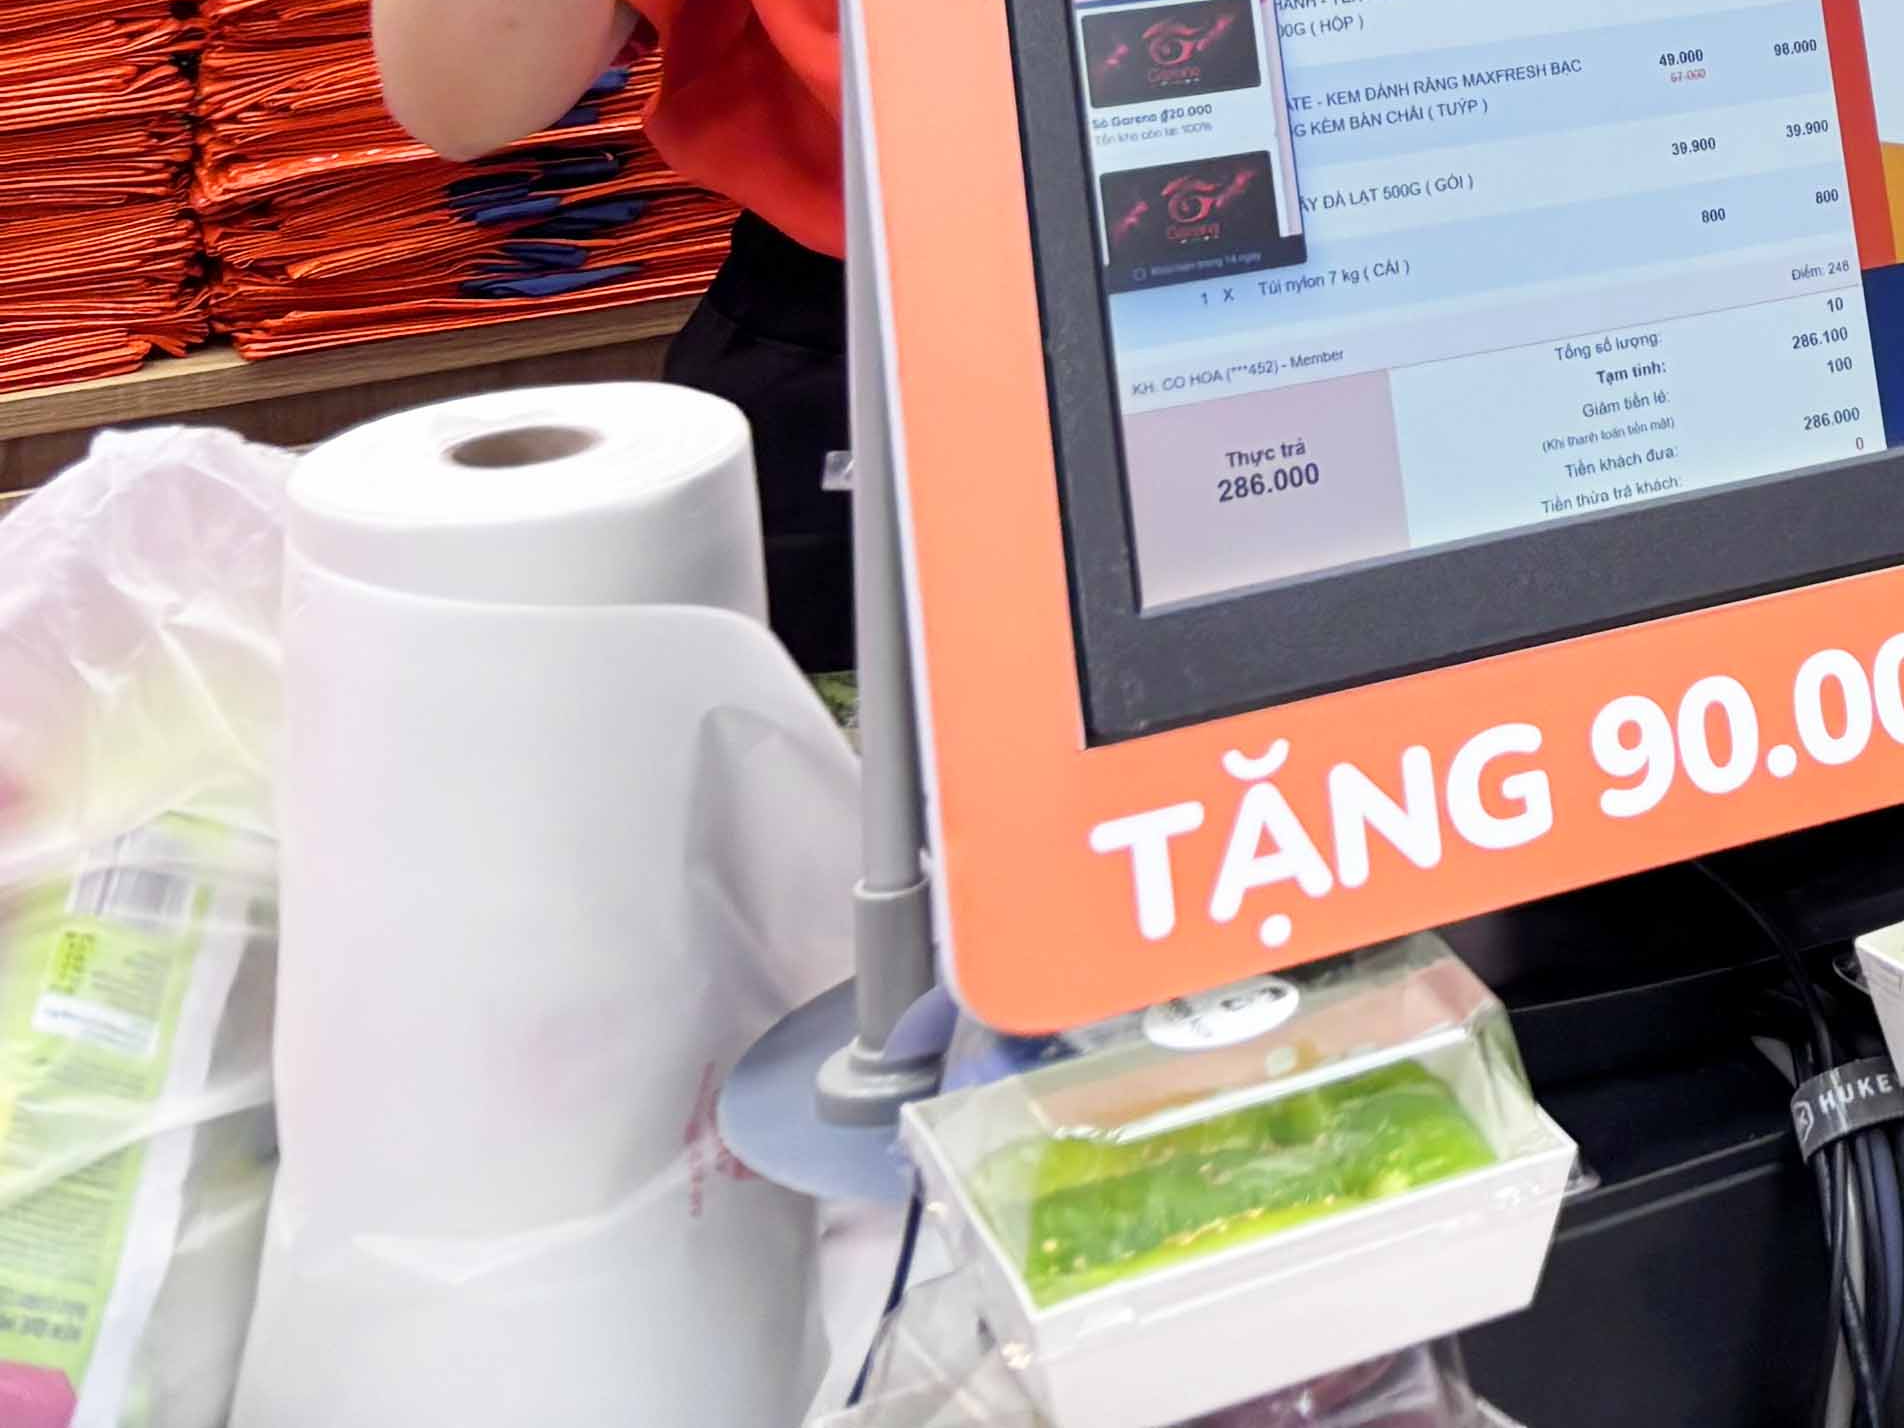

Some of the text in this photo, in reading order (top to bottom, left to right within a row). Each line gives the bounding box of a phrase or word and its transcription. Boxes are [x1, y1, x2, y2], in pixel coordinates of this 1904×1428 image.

[1792, 327, 1848, 350] 286.100
[1803, 407, 1860, 431] 286.000
[1226, 444, 1275, 469] Thực
[1217, 462, 1319, 503] 286.000
[1088, 736, 1554, 950] TẶNG
